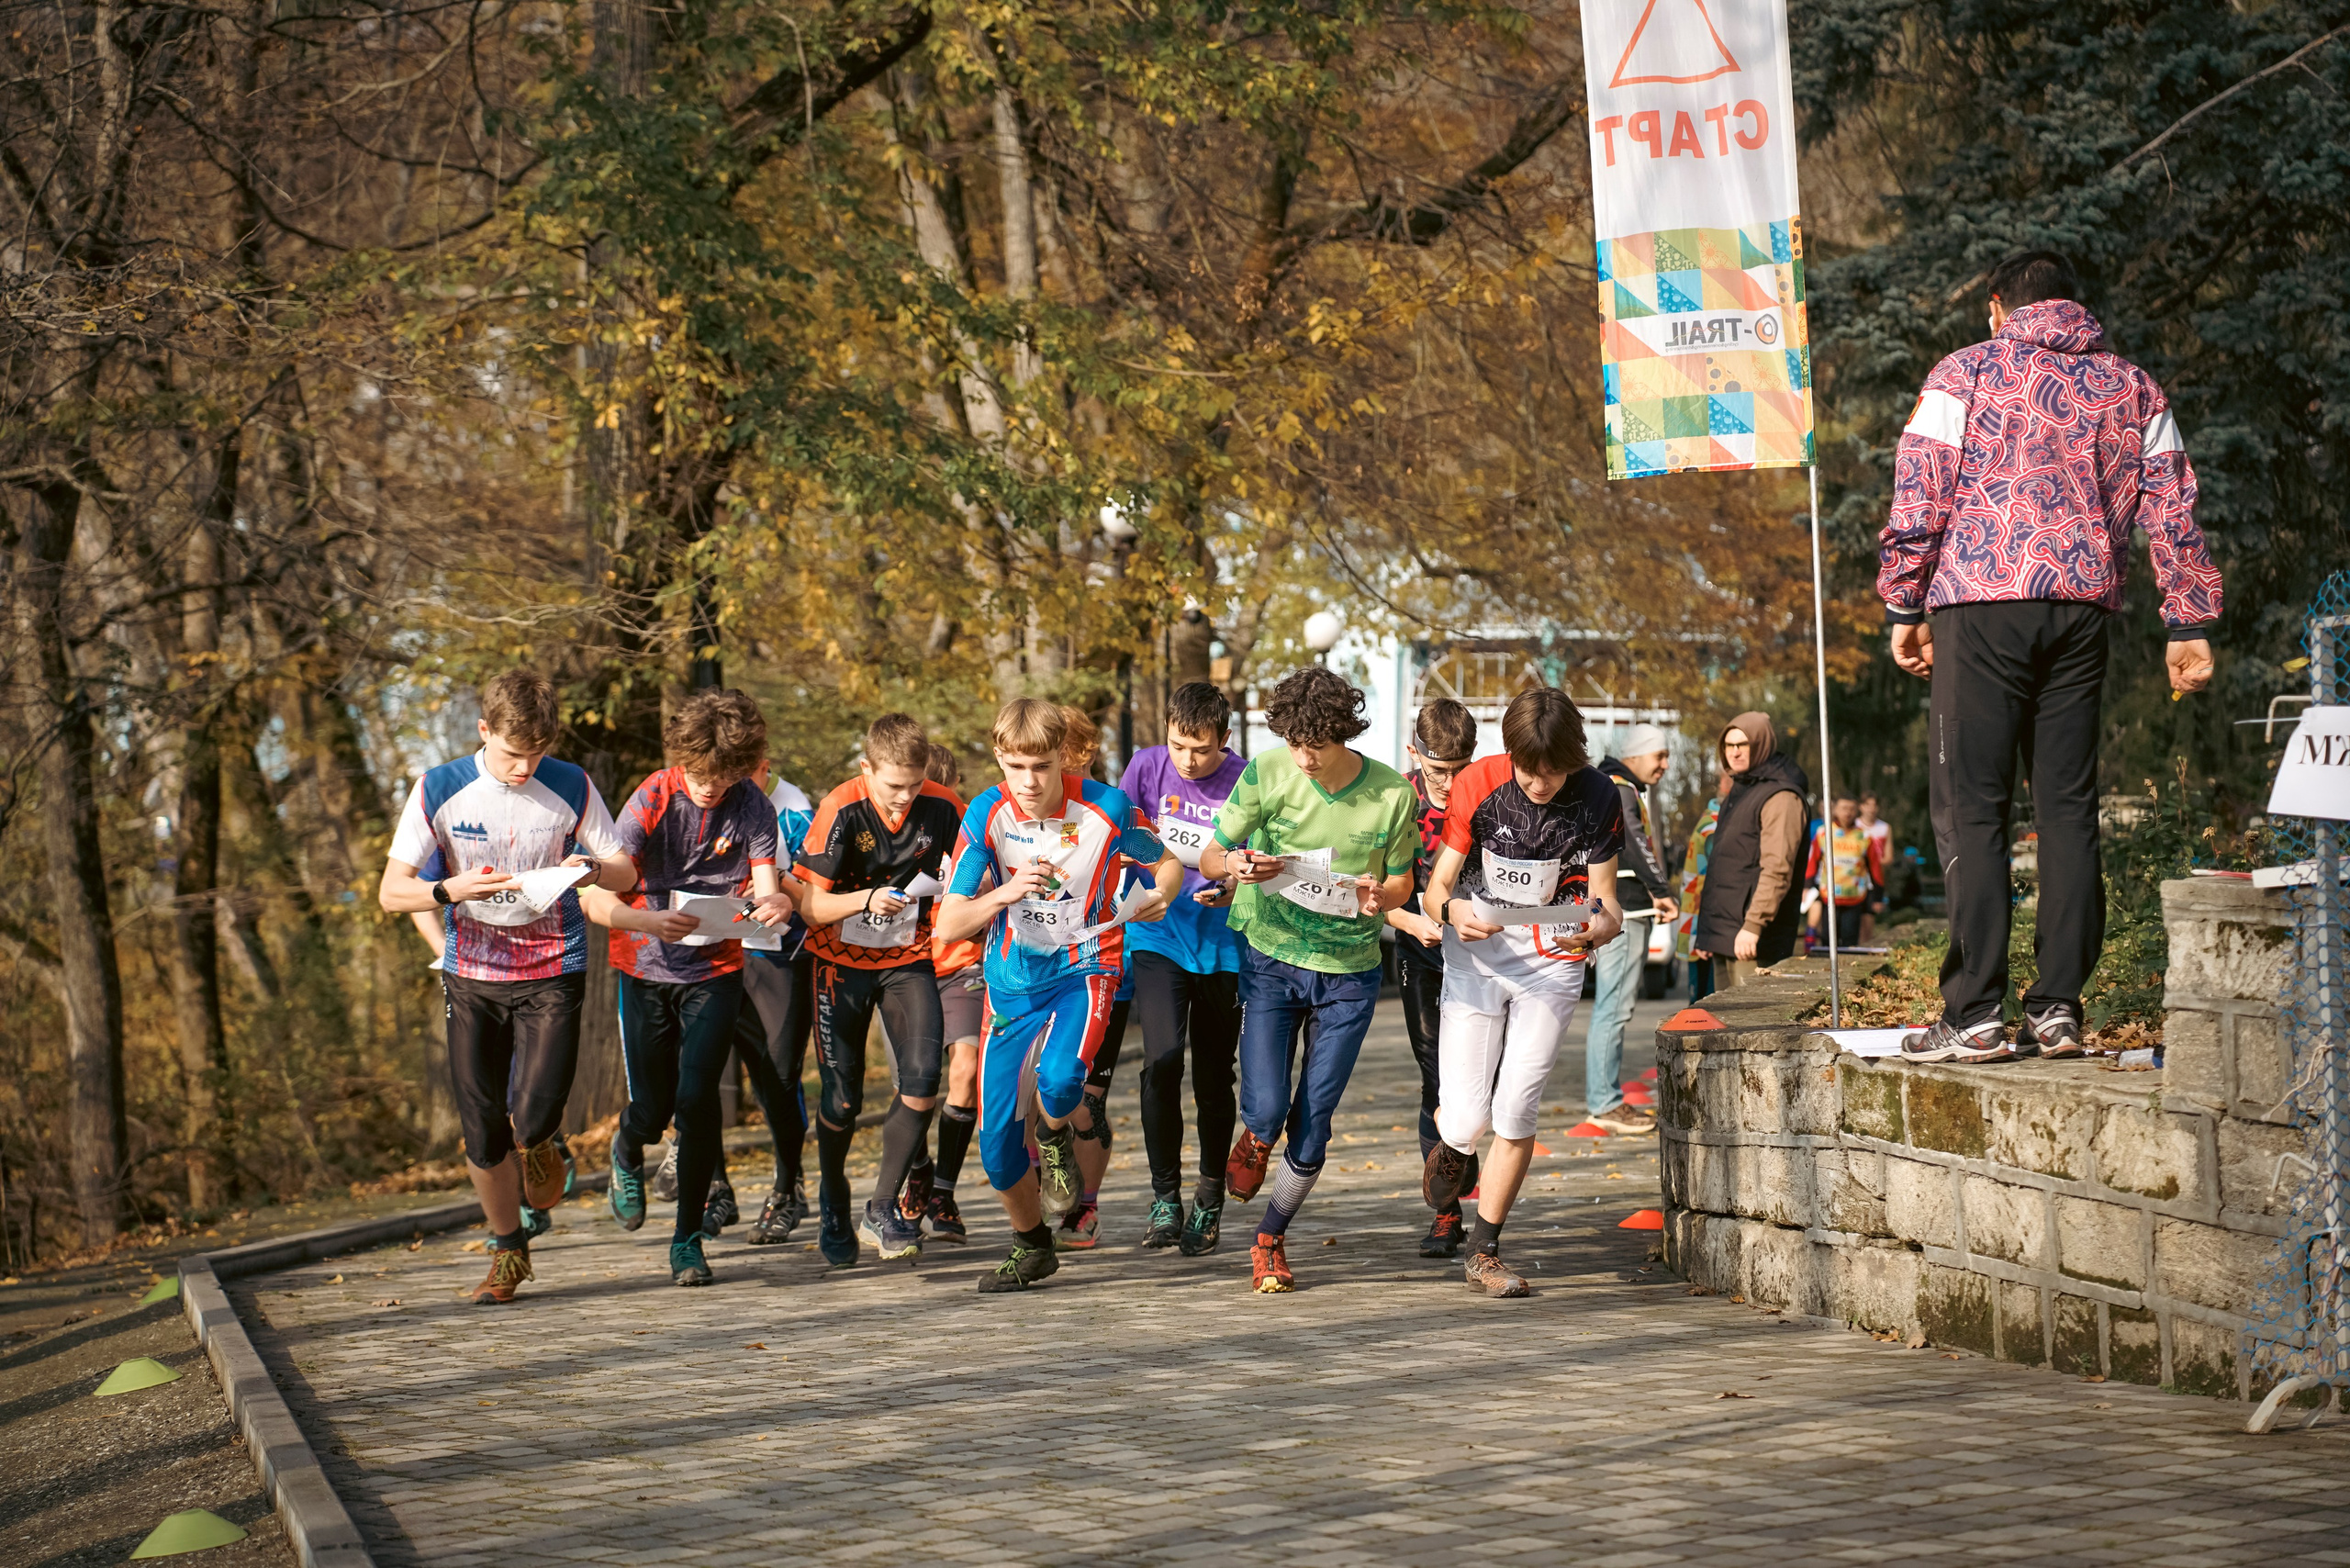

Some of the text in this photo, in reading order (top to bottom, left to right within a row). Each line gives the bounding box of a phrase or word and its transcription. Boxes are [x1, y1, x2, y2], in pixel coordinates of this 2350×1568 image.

[1169, 828, 1201, 847] 262
[1492, 877, 1514, 889] МЖ16
[1496, 868, 1531, 885] 260
[481, 890, 517, 904] 66
[1292, 886, 1315, 900] МЖ16
[1341, 892, 1346, 901] 1
[1023, 909, 1057, 925] 263
[1065, 916, 1069, 925] 1
[856, 923, 878, 933] МЖ16
